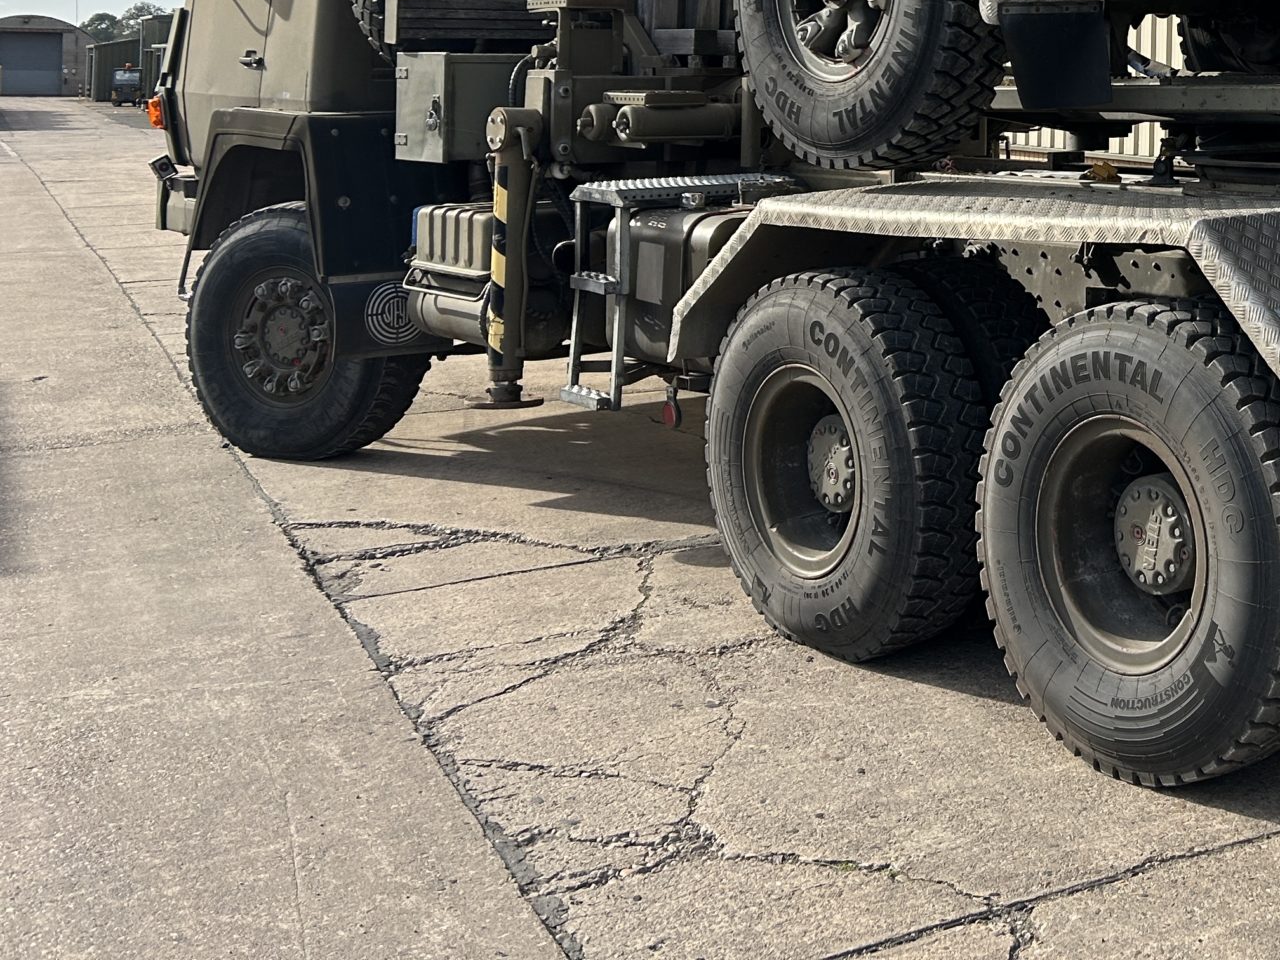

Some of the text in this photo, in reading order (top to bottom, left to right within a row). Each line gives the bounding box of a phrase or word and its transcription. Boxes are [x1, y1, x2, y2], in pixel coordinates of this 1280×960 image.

[765, 76, 802, 126] HDC
[809, 320, 892, 557] CONTINENTAL
[994, 350, 1164, 488] CONTINENTAL
[1110, 671, 1194, 710] CONSTRUCTION
